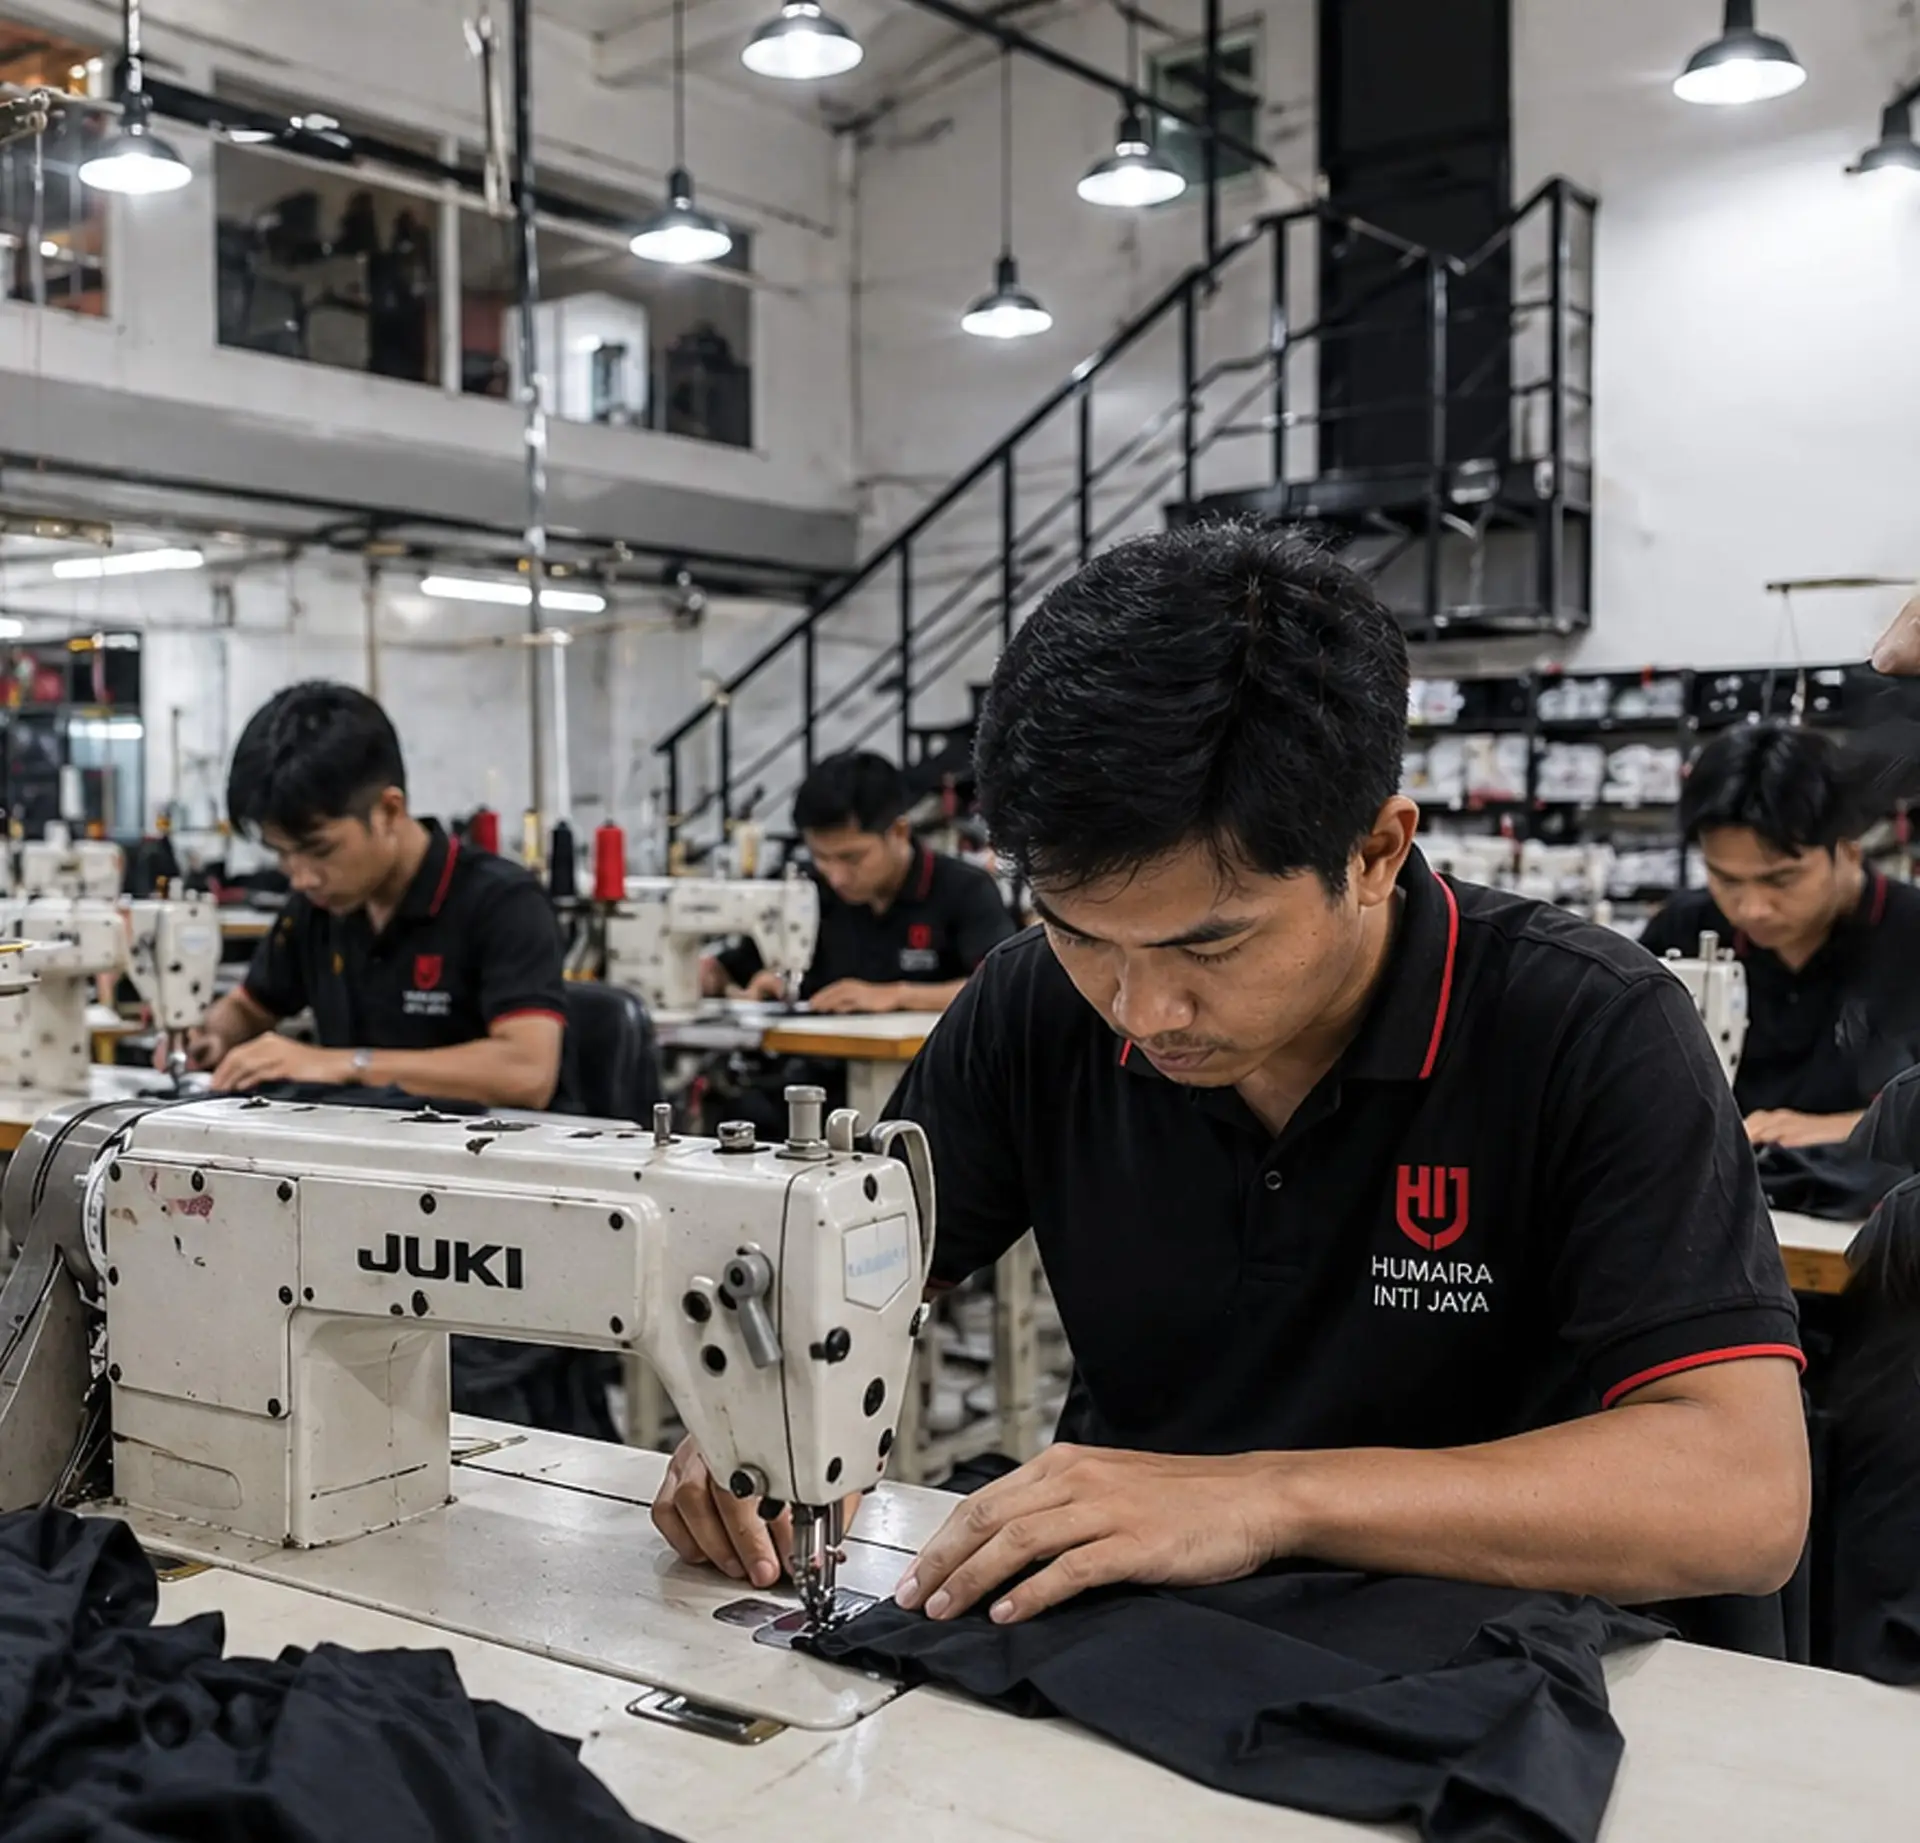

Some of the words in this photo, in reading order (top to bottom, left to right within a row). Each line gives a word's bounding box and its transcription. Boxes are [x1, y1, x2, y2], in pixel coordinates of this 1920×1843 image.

[357, 1233, 523, 1290] JUKI
[1371, 1255, 1494, 1284] HUMAIRA
[1373, 1284, 1419, 1310] INTI
[1427, 1290, 1490, 1313] JAYA
